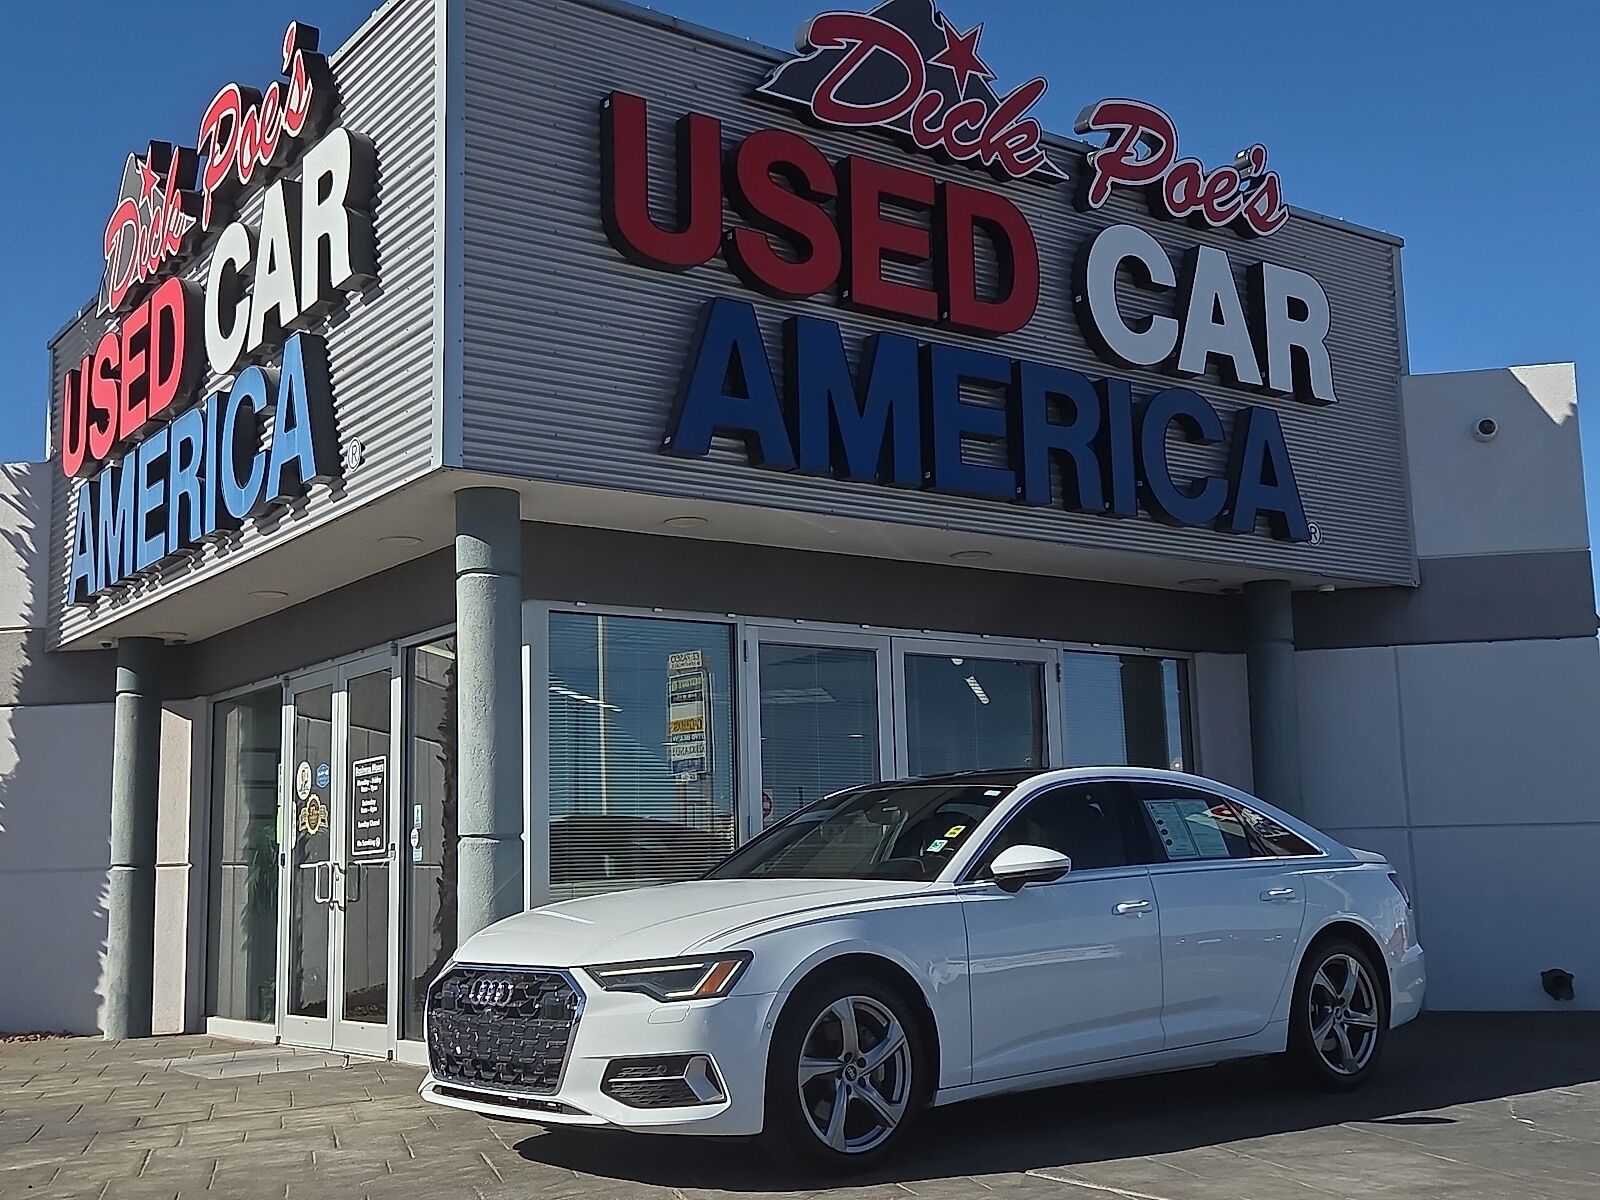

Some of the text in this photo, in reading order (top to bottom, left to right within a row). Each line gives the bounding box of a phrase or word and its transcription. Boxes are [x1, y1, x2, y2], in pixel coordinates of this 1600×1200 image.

[105, 21, 314, 312] Dick Poe's
[605, 91, 1338, 403] USED CAR
[809, 11, 1290, 238] Dick Poe's
[62, 126, 354, 478] USED CAR
[664, 296, 1311, 543] AMERICA
[67, 329, 318, 607] AMERICA
